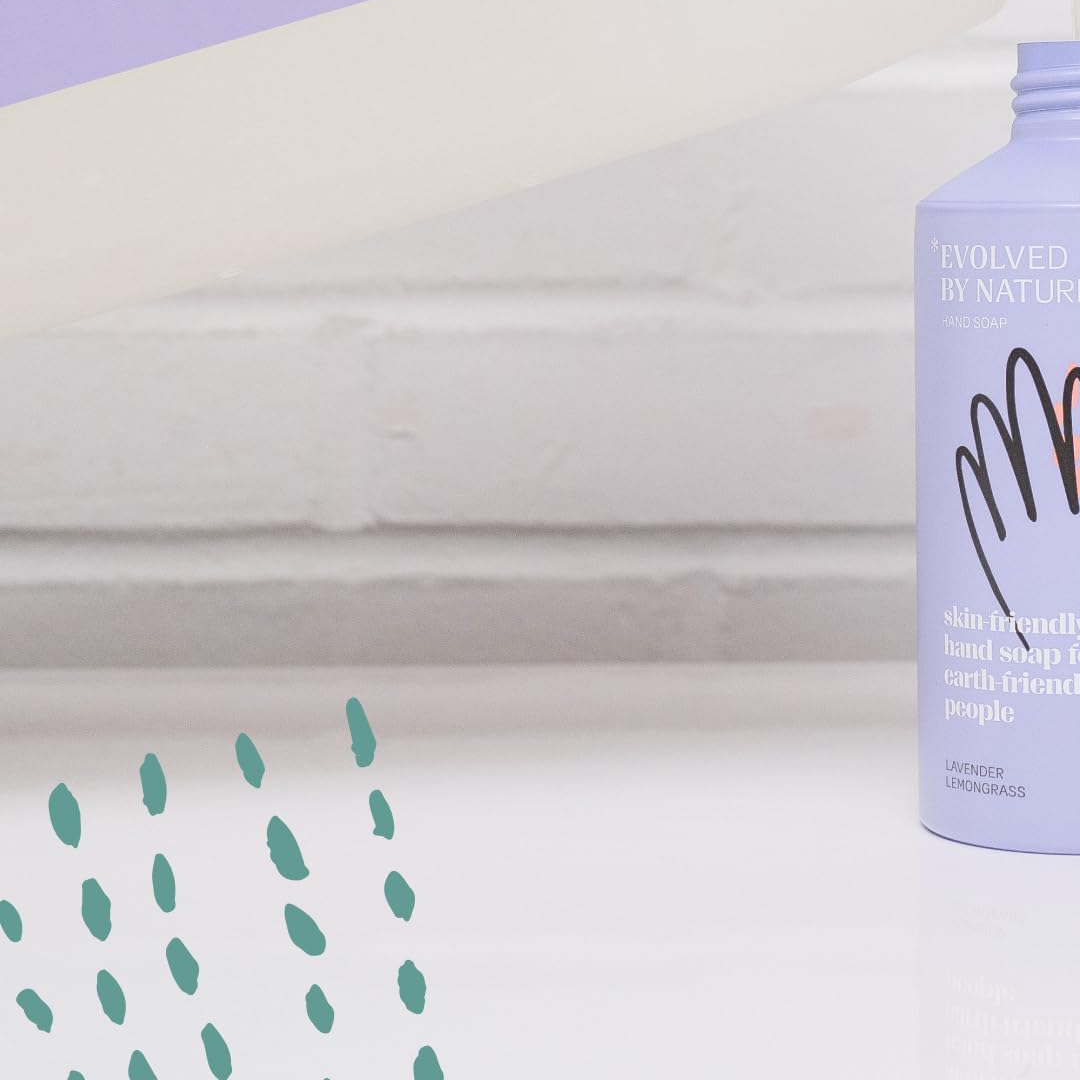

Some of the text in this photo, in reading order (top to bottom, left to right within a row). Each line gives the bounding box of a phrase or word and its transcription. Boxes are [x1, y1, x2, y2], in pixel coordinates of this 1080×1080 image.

[940, 276, 970, 303] BY
[942, 314, 1008, 329] HAND SOAP
[944, 634, 993, 662] hand
[999, 644, 1062, 671] soap
[944, 696, 1016, 726] people
[945, 759, 1005, 781] LAVENDER
[945, 775, 1027, 799] LEMONGRASS
